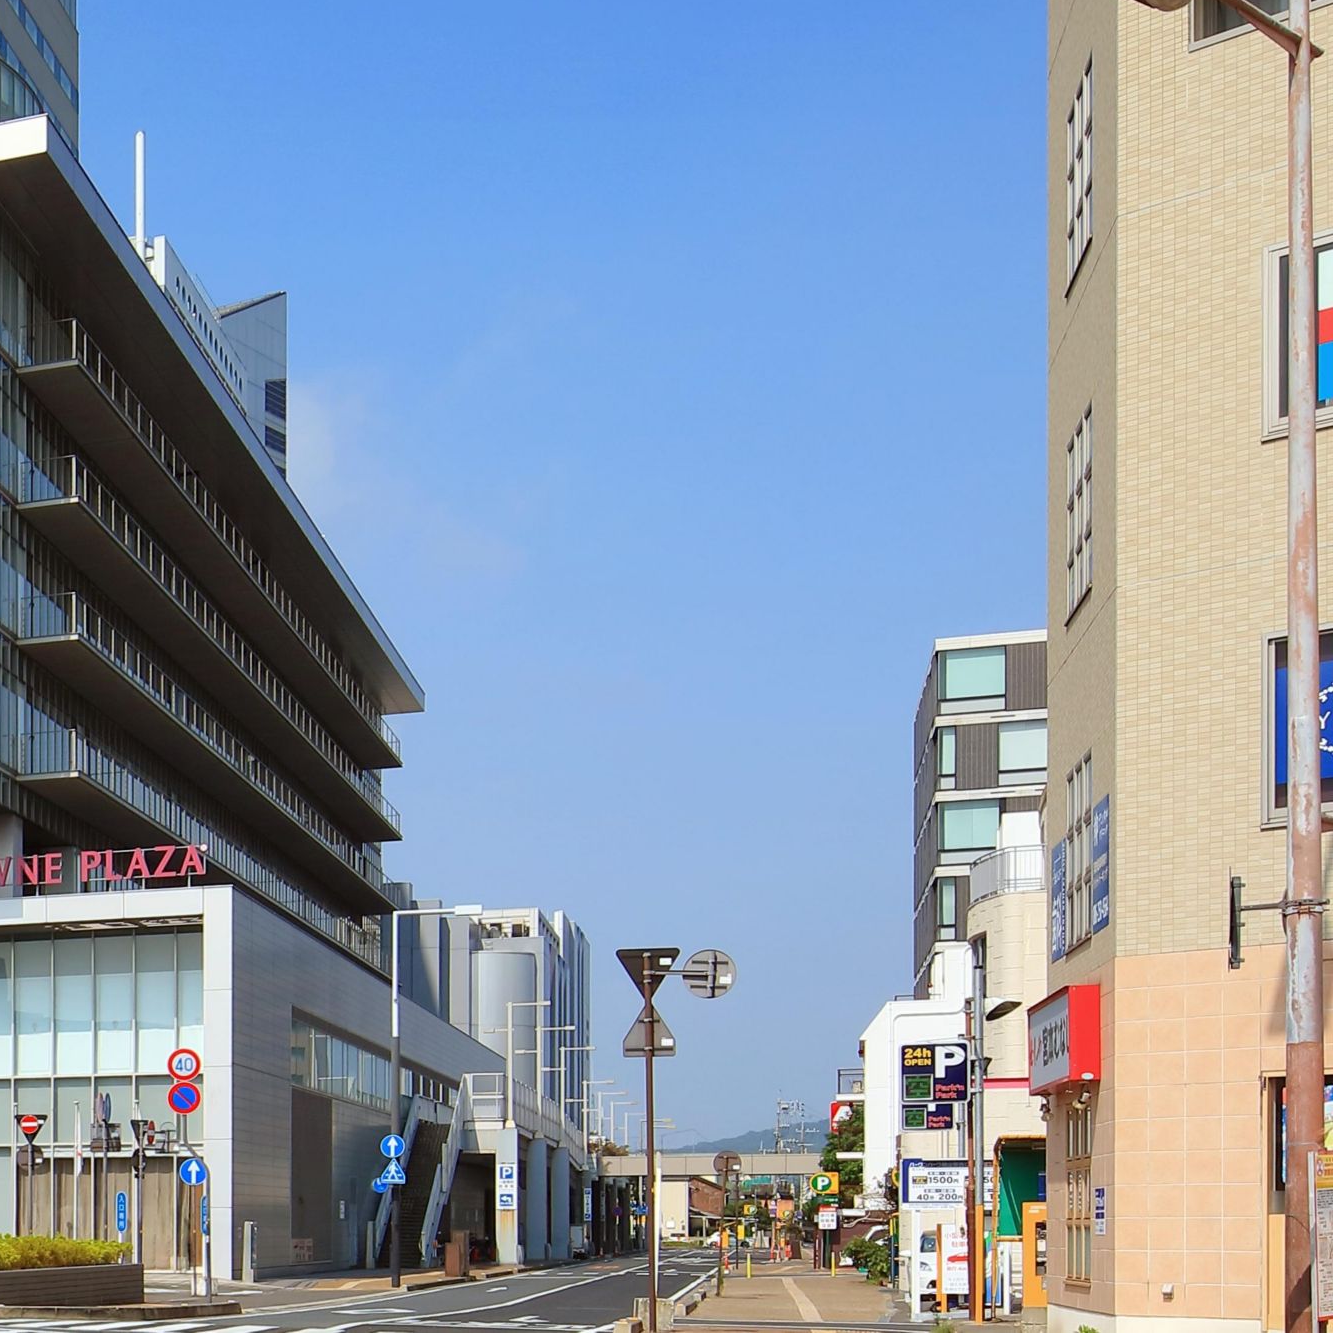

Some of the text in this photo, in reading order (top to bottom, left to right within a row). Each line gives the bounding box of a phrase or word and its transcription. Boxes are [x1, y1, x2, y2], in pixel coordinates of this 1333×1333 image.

[79, 844, 207, 882] PLAZA
[174, 1057, 194, 1072] 40
[904, 1045, 966, 1079] 24h P
[904, 1058, 932, 1067] OPEN
[817, 1177, 830, 1190] P
